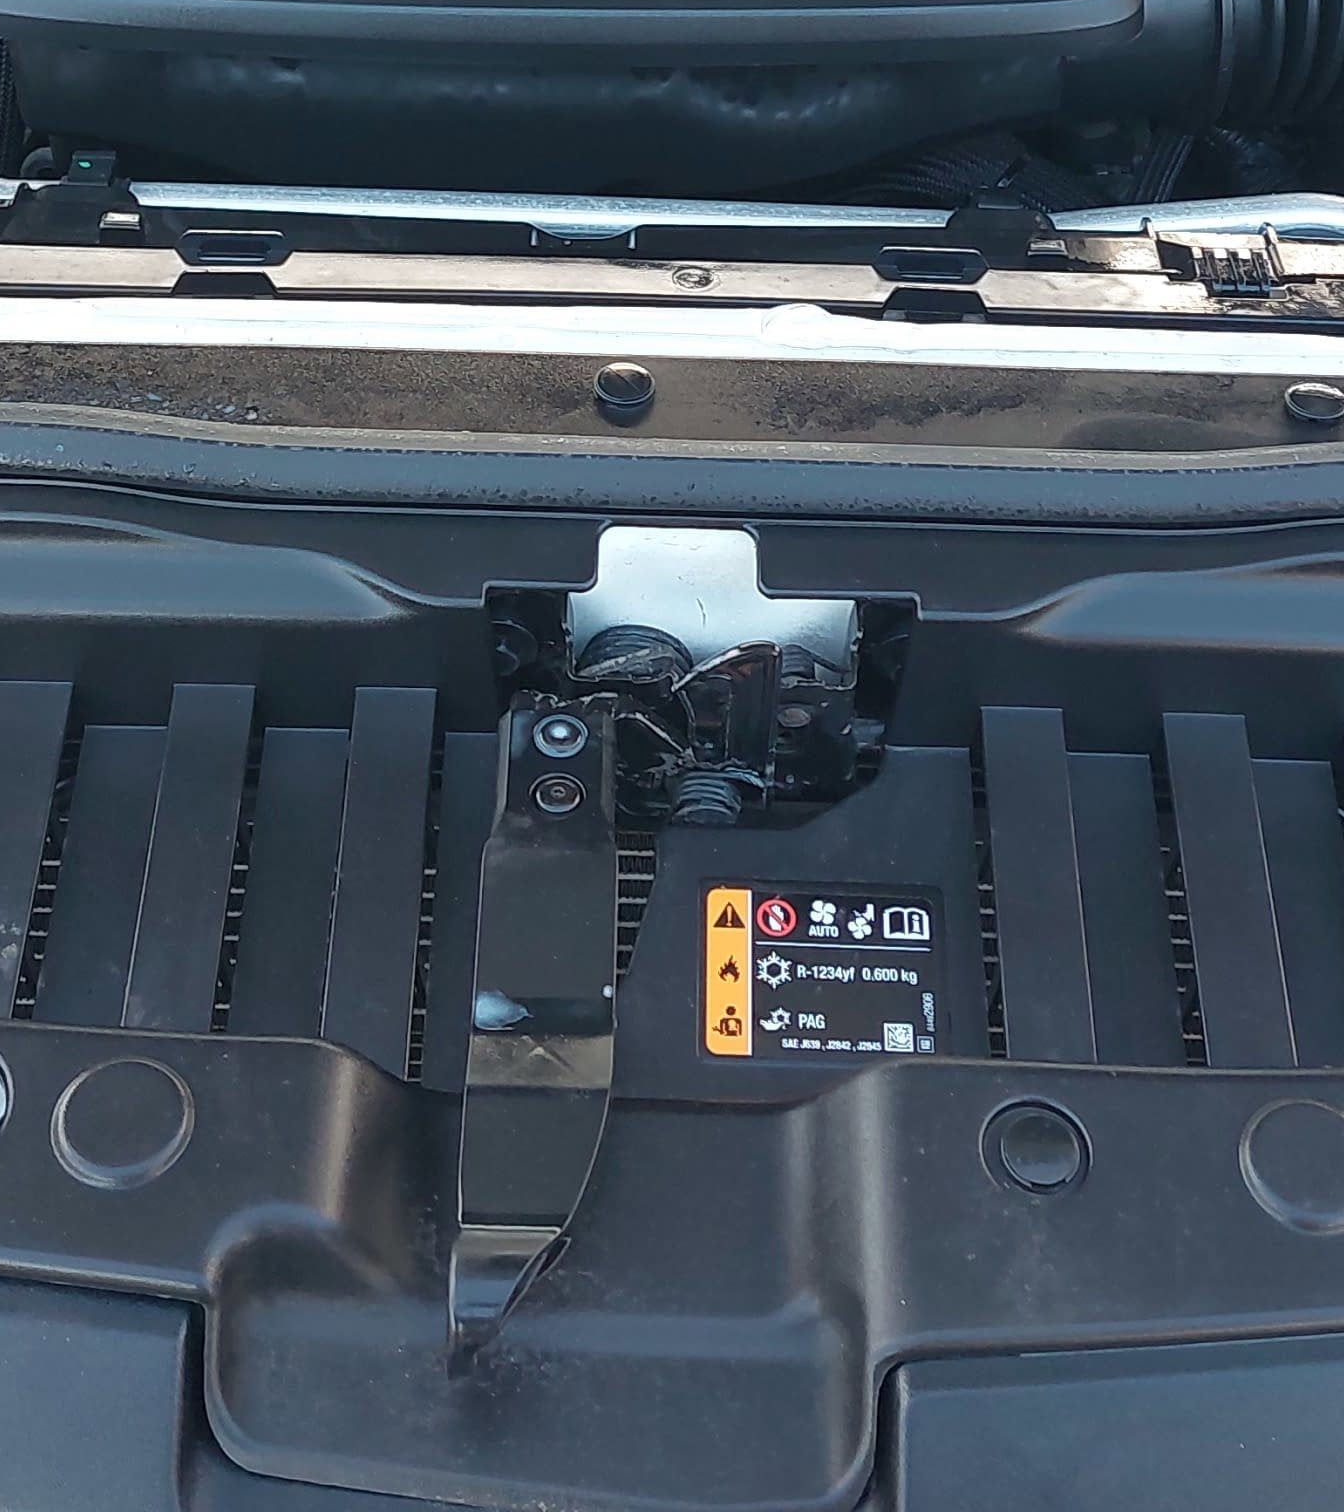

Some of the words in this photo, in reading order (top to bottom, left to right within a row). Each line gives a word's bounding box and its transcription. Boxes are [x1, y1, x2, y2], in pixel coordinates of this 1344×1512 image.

[808, 925, 839, 937] AUTO
[796, 965, 855, 982] R-1234yf
[861, 967, 899, 981] 0.600
[900, 968, 918, 984] kg
[797, 1013, 826, 1029] PAG
